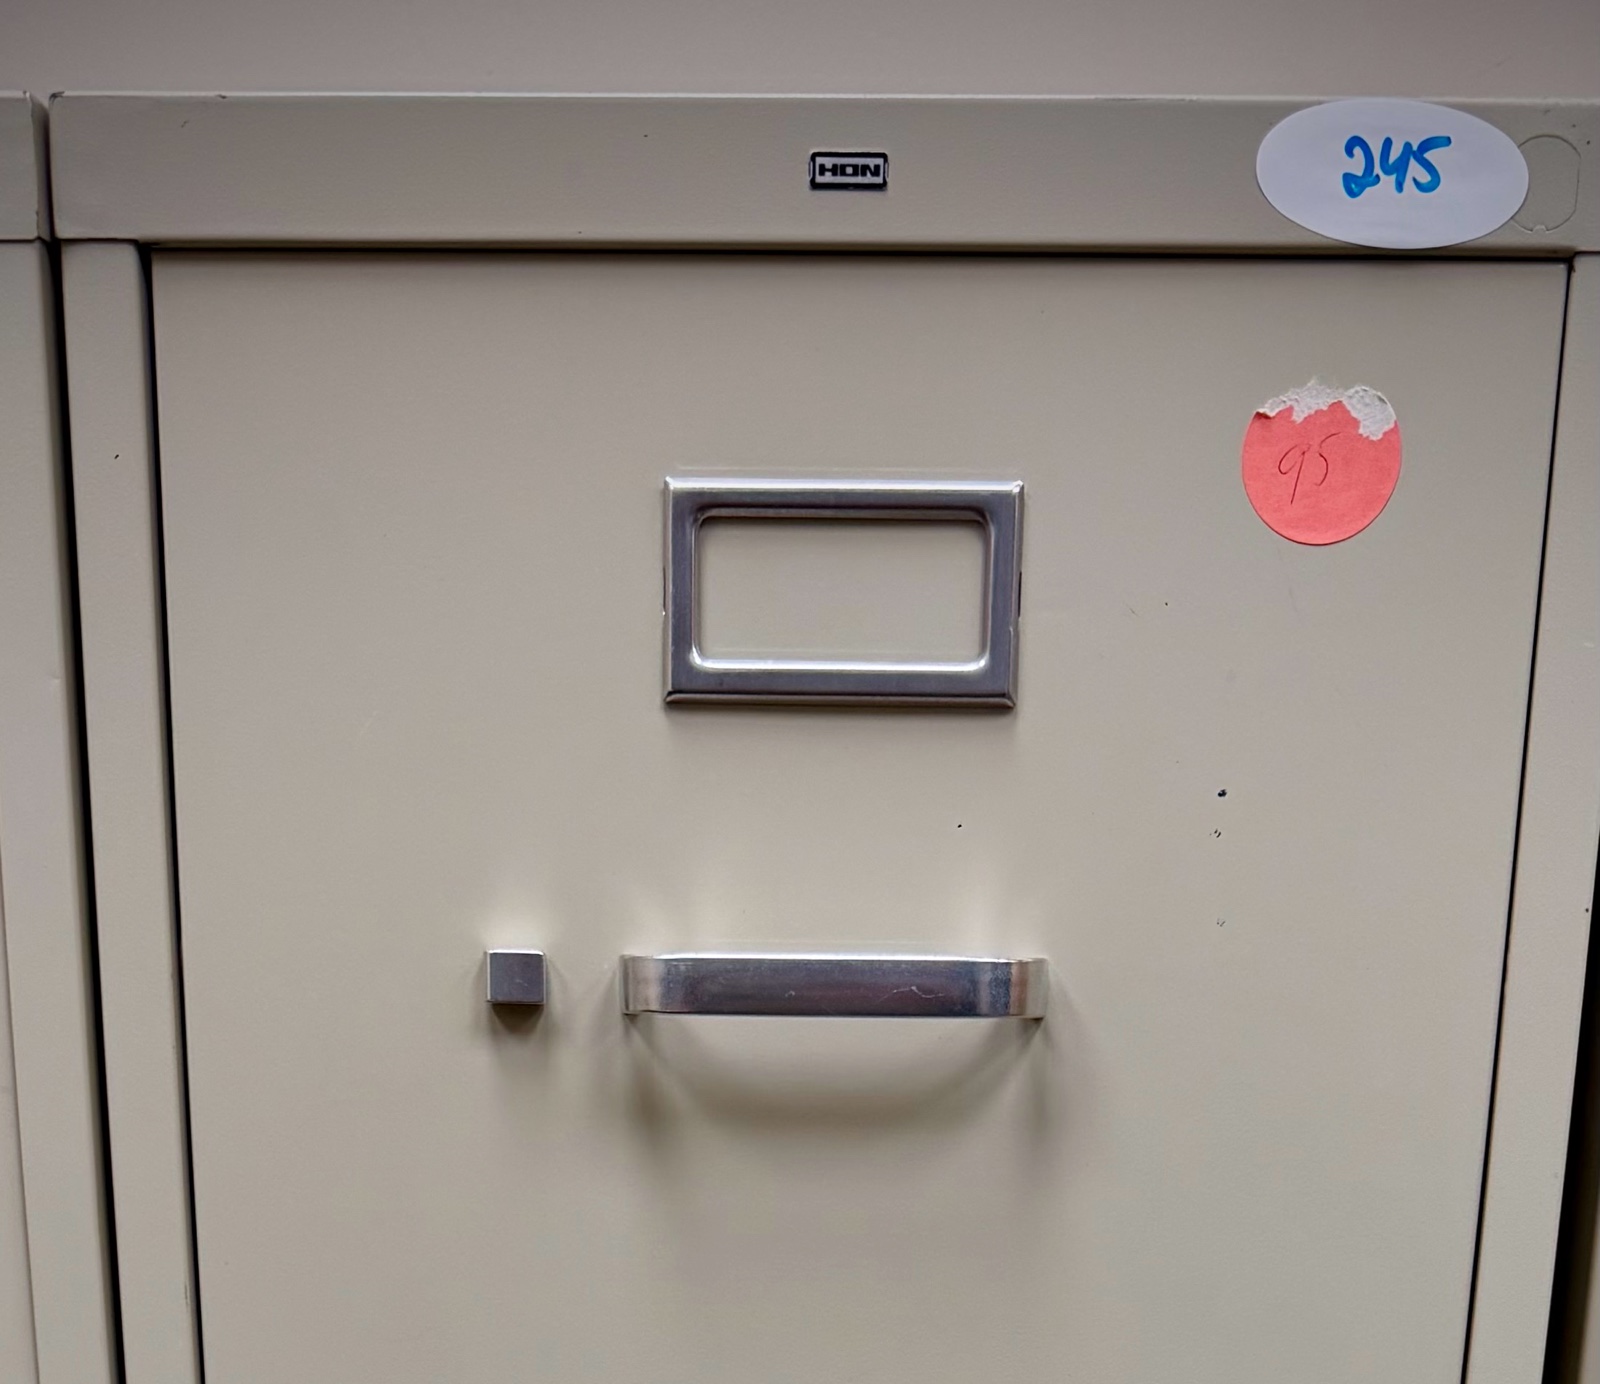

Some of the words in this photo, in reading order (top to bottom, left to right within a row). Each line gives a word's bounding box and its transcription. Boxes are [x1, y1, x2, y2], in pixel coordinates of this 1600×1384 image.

[818, 163, 881, 177] HON
[1342, 135, 1452, 199] 245
[1278, 431, 1342, 504] 95
